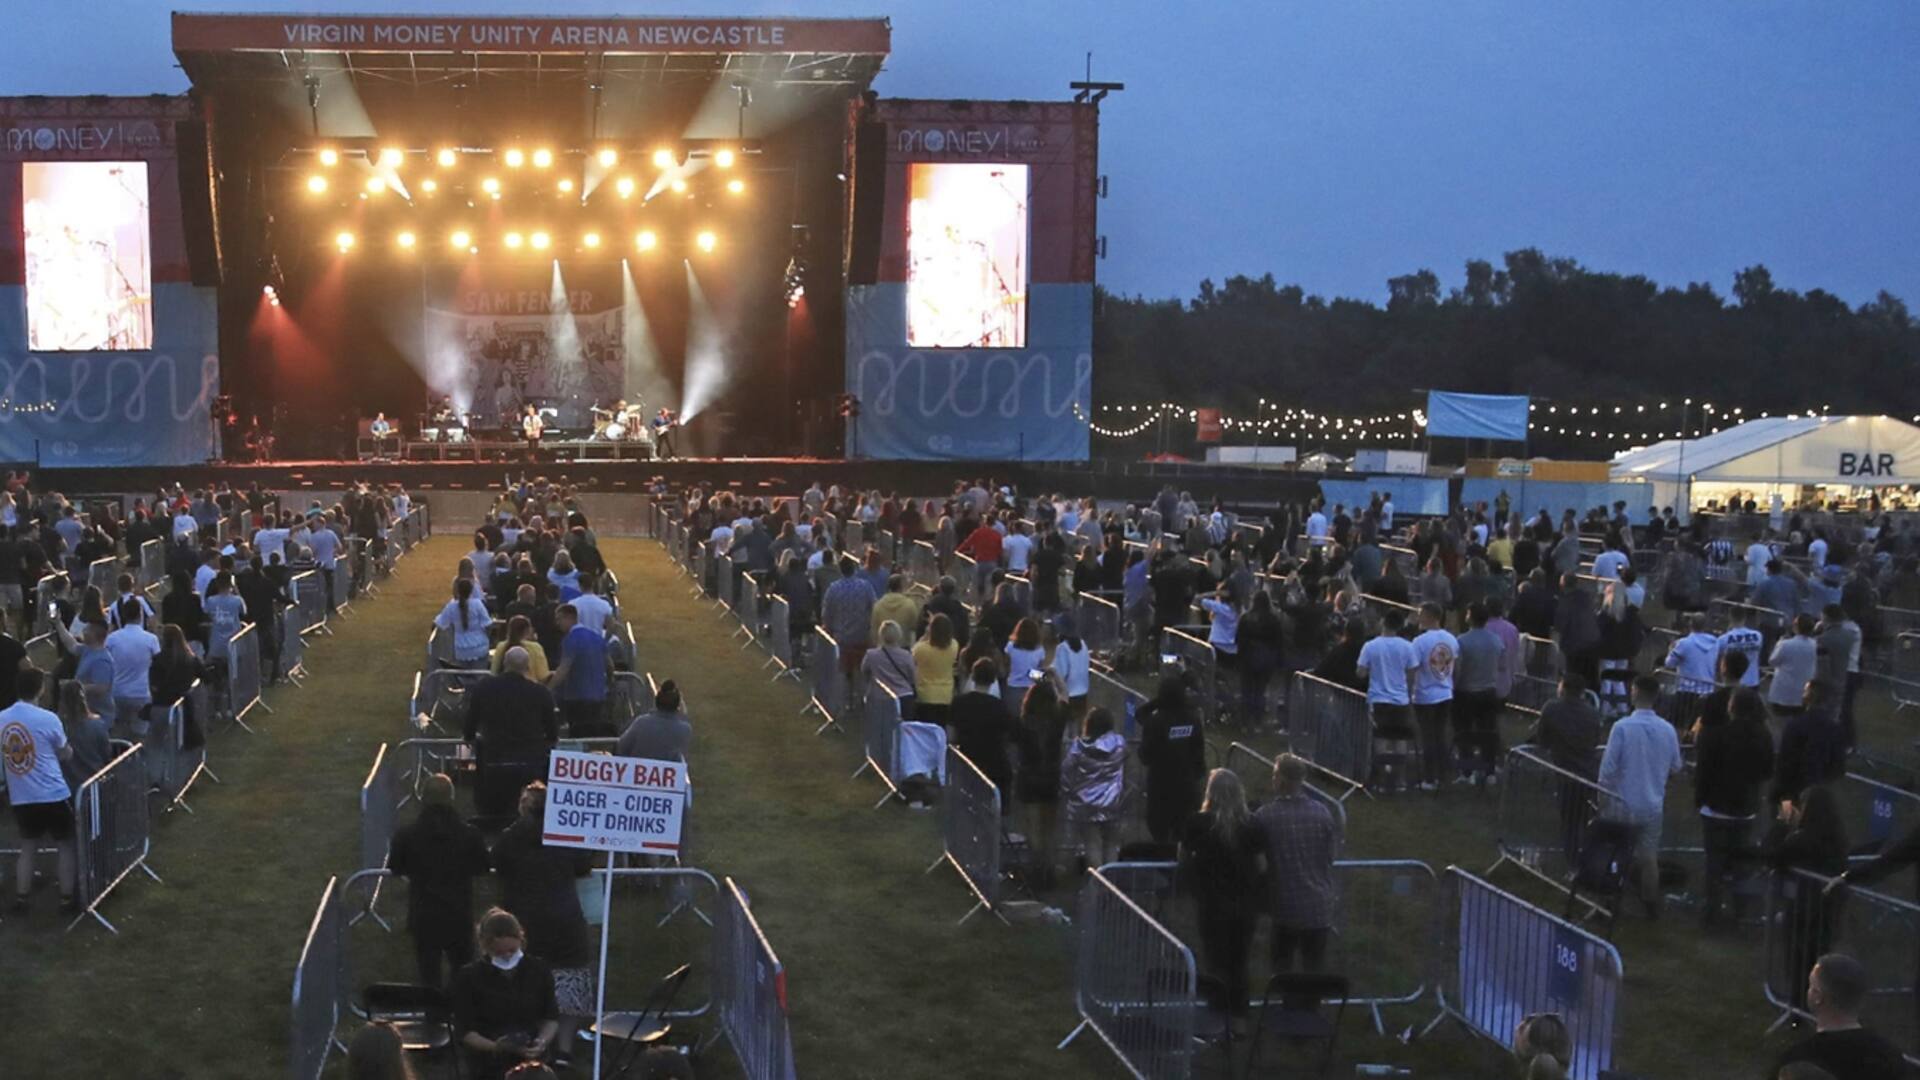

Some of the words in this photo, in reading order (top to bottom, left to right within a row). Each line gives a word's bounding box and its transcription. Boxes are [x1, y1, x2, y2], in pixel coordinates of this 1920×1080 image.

[284, 24, 366, 43] VIRGIN
[374, 25, 462, 44] MONEY
[471, 26, 541, 44] UNITY
[550, 26, 630, 44] ARENA
[638, 26, 784, 44] NEWCASTLE
[7, 127, 113, 151] MONEY
[898, 129, 1001, 152] MONEY
[463, 290, 510, 314] SAM
[517, 289, 593, 314] FENER
[1839, 453, 1895, 476] BAR
[554, 757, 628, 783] BUGGY
[633, 765, 677, 788] BAR
[553, 788, 607, 809] LAGER
[624, 795, 673, 815] CIDER
[557, 809, 601, 829] SOFT
[604, 813, 666, 834] DRINKS
[1556, 944, 1577, 972] 188
